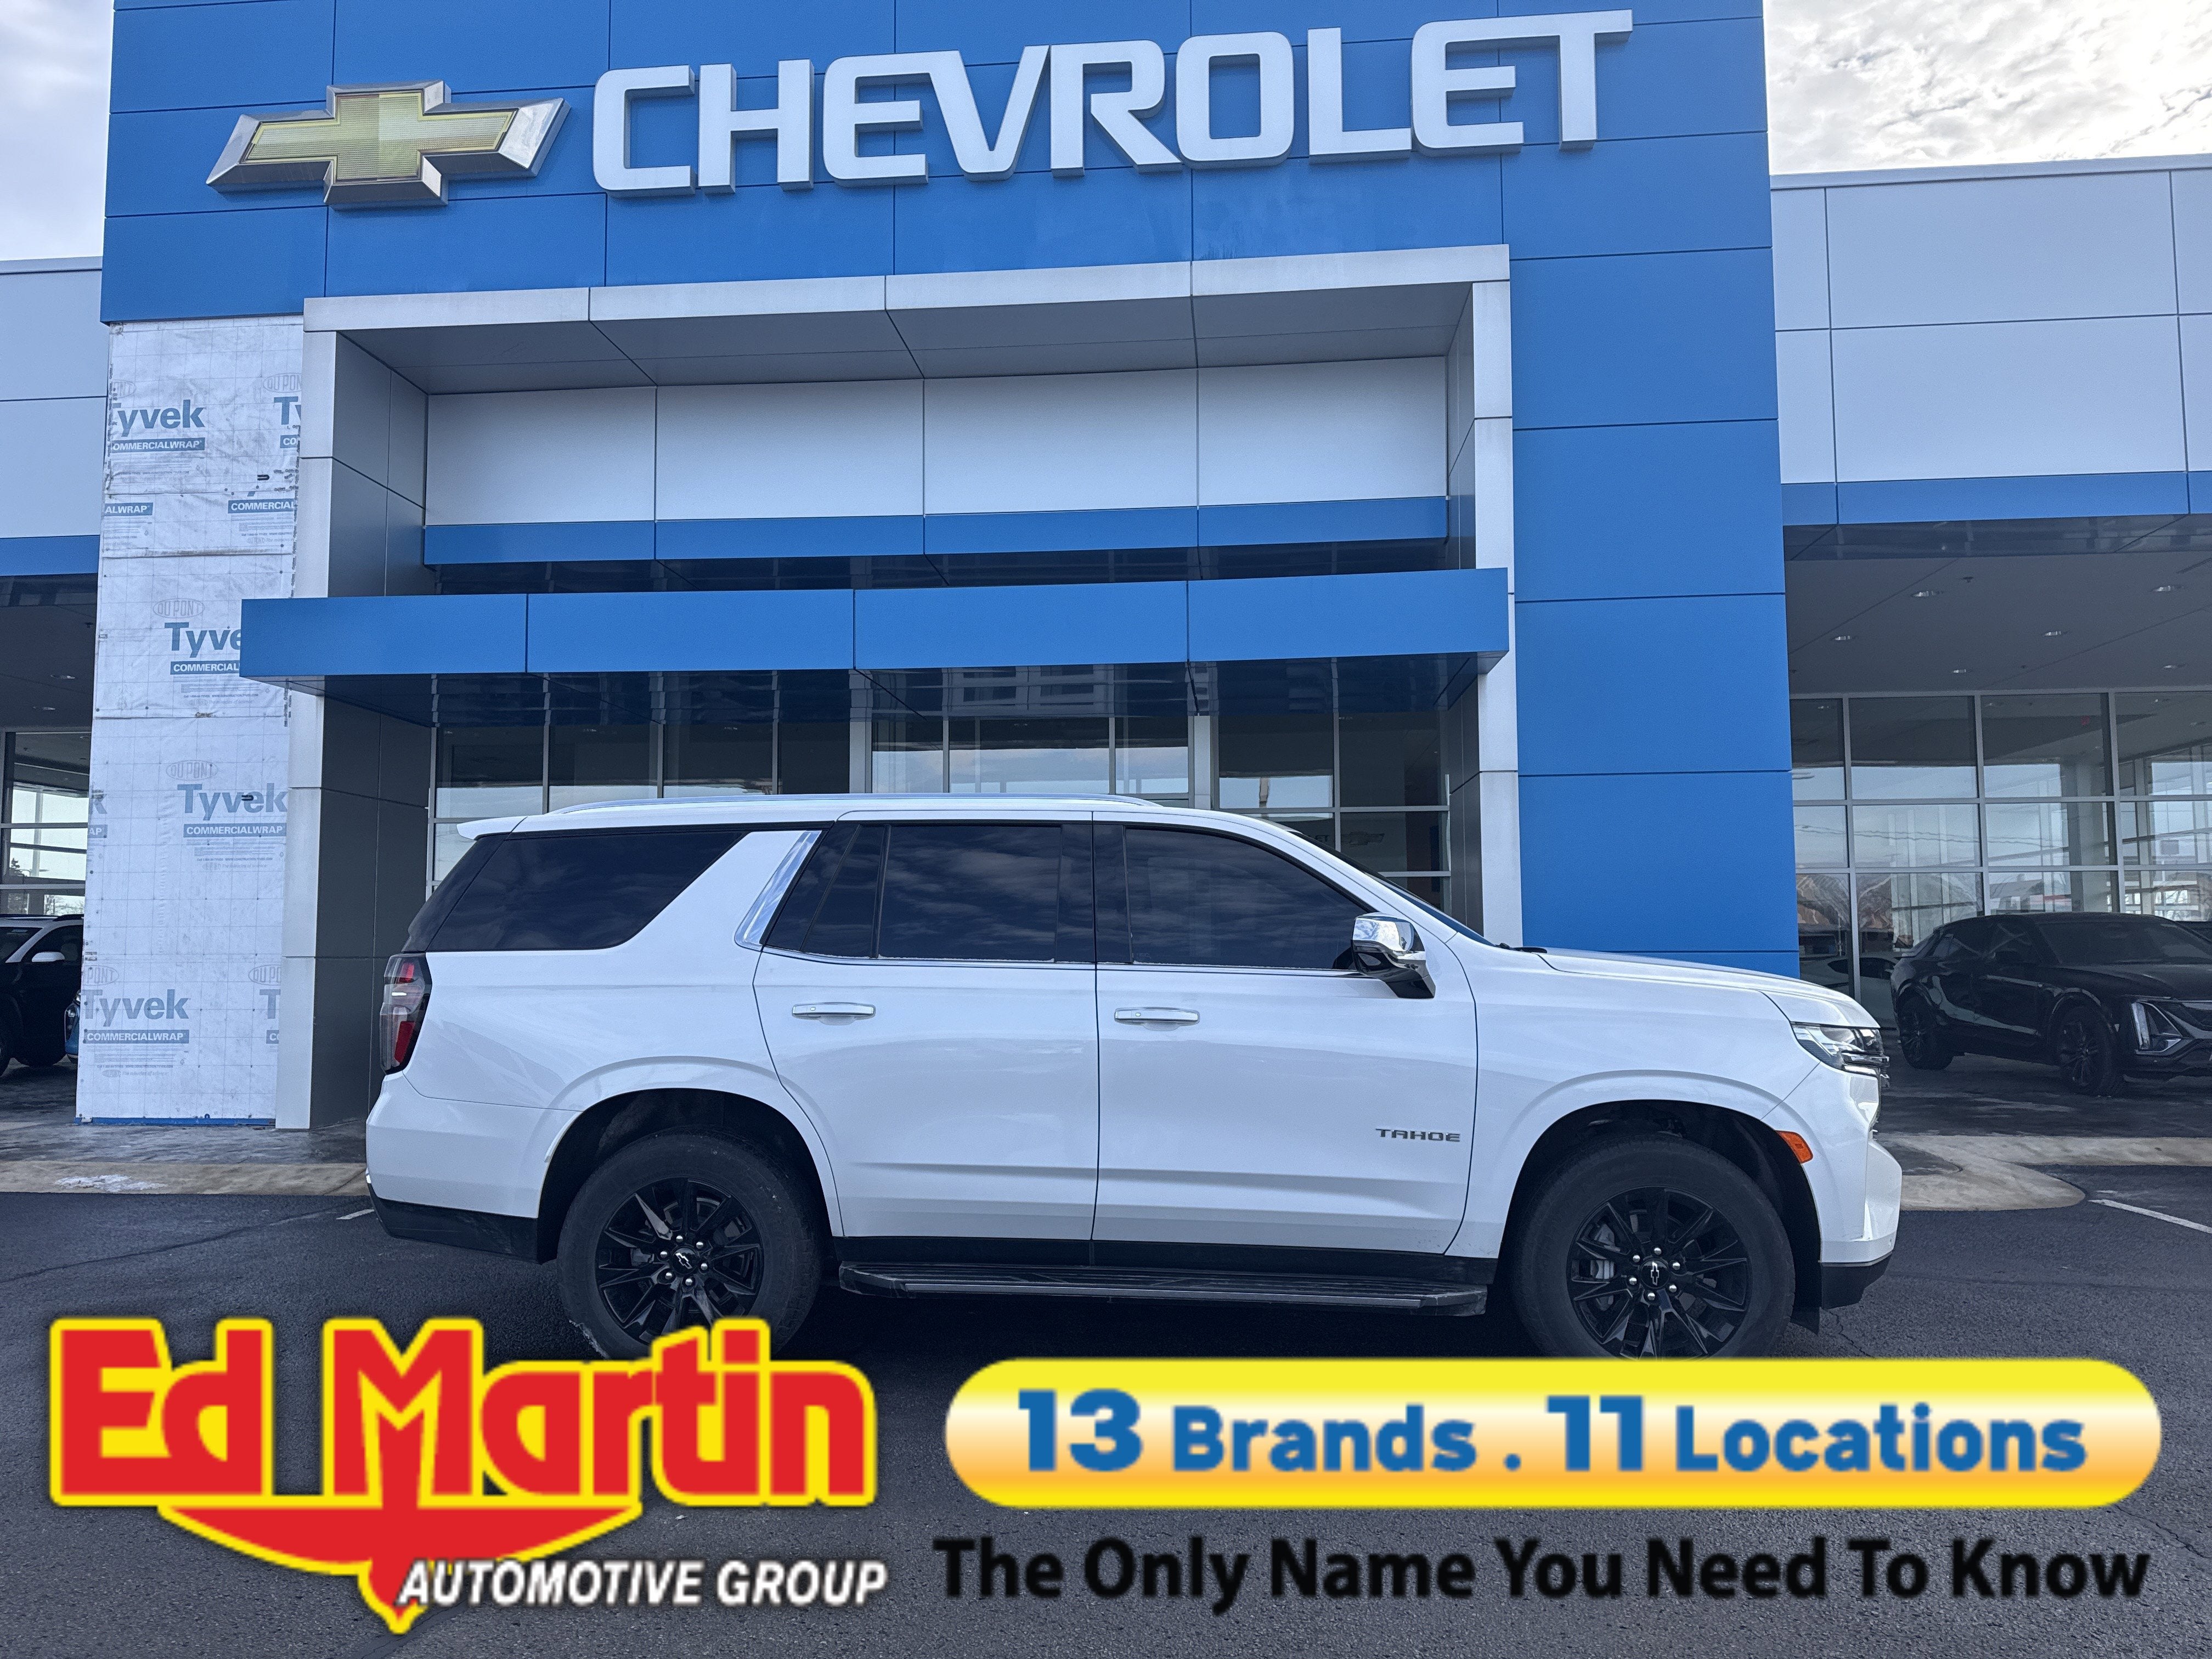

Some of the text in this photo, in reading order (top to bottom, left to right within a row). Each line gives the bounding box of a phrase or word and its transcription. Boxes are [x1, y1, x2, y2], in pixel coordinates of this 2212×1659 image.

[592, 8, 1633, 198] CHEVROLET
[112, 399, 205, 437] yvek
[105, 505, 148, 514] ALWRAP
[173, 663, 239, 672] COMMERCIAL
[177, 782, 288, 821] Tyvek
[186, 826, 284, 835] COMMERCIALWRAP
[81, 989, 190, 1027] Tyvek
[87, 1032, 184, 1041] COMMERCIALWRAP
[1375, 1127, 1460, 1142] TAHOE
